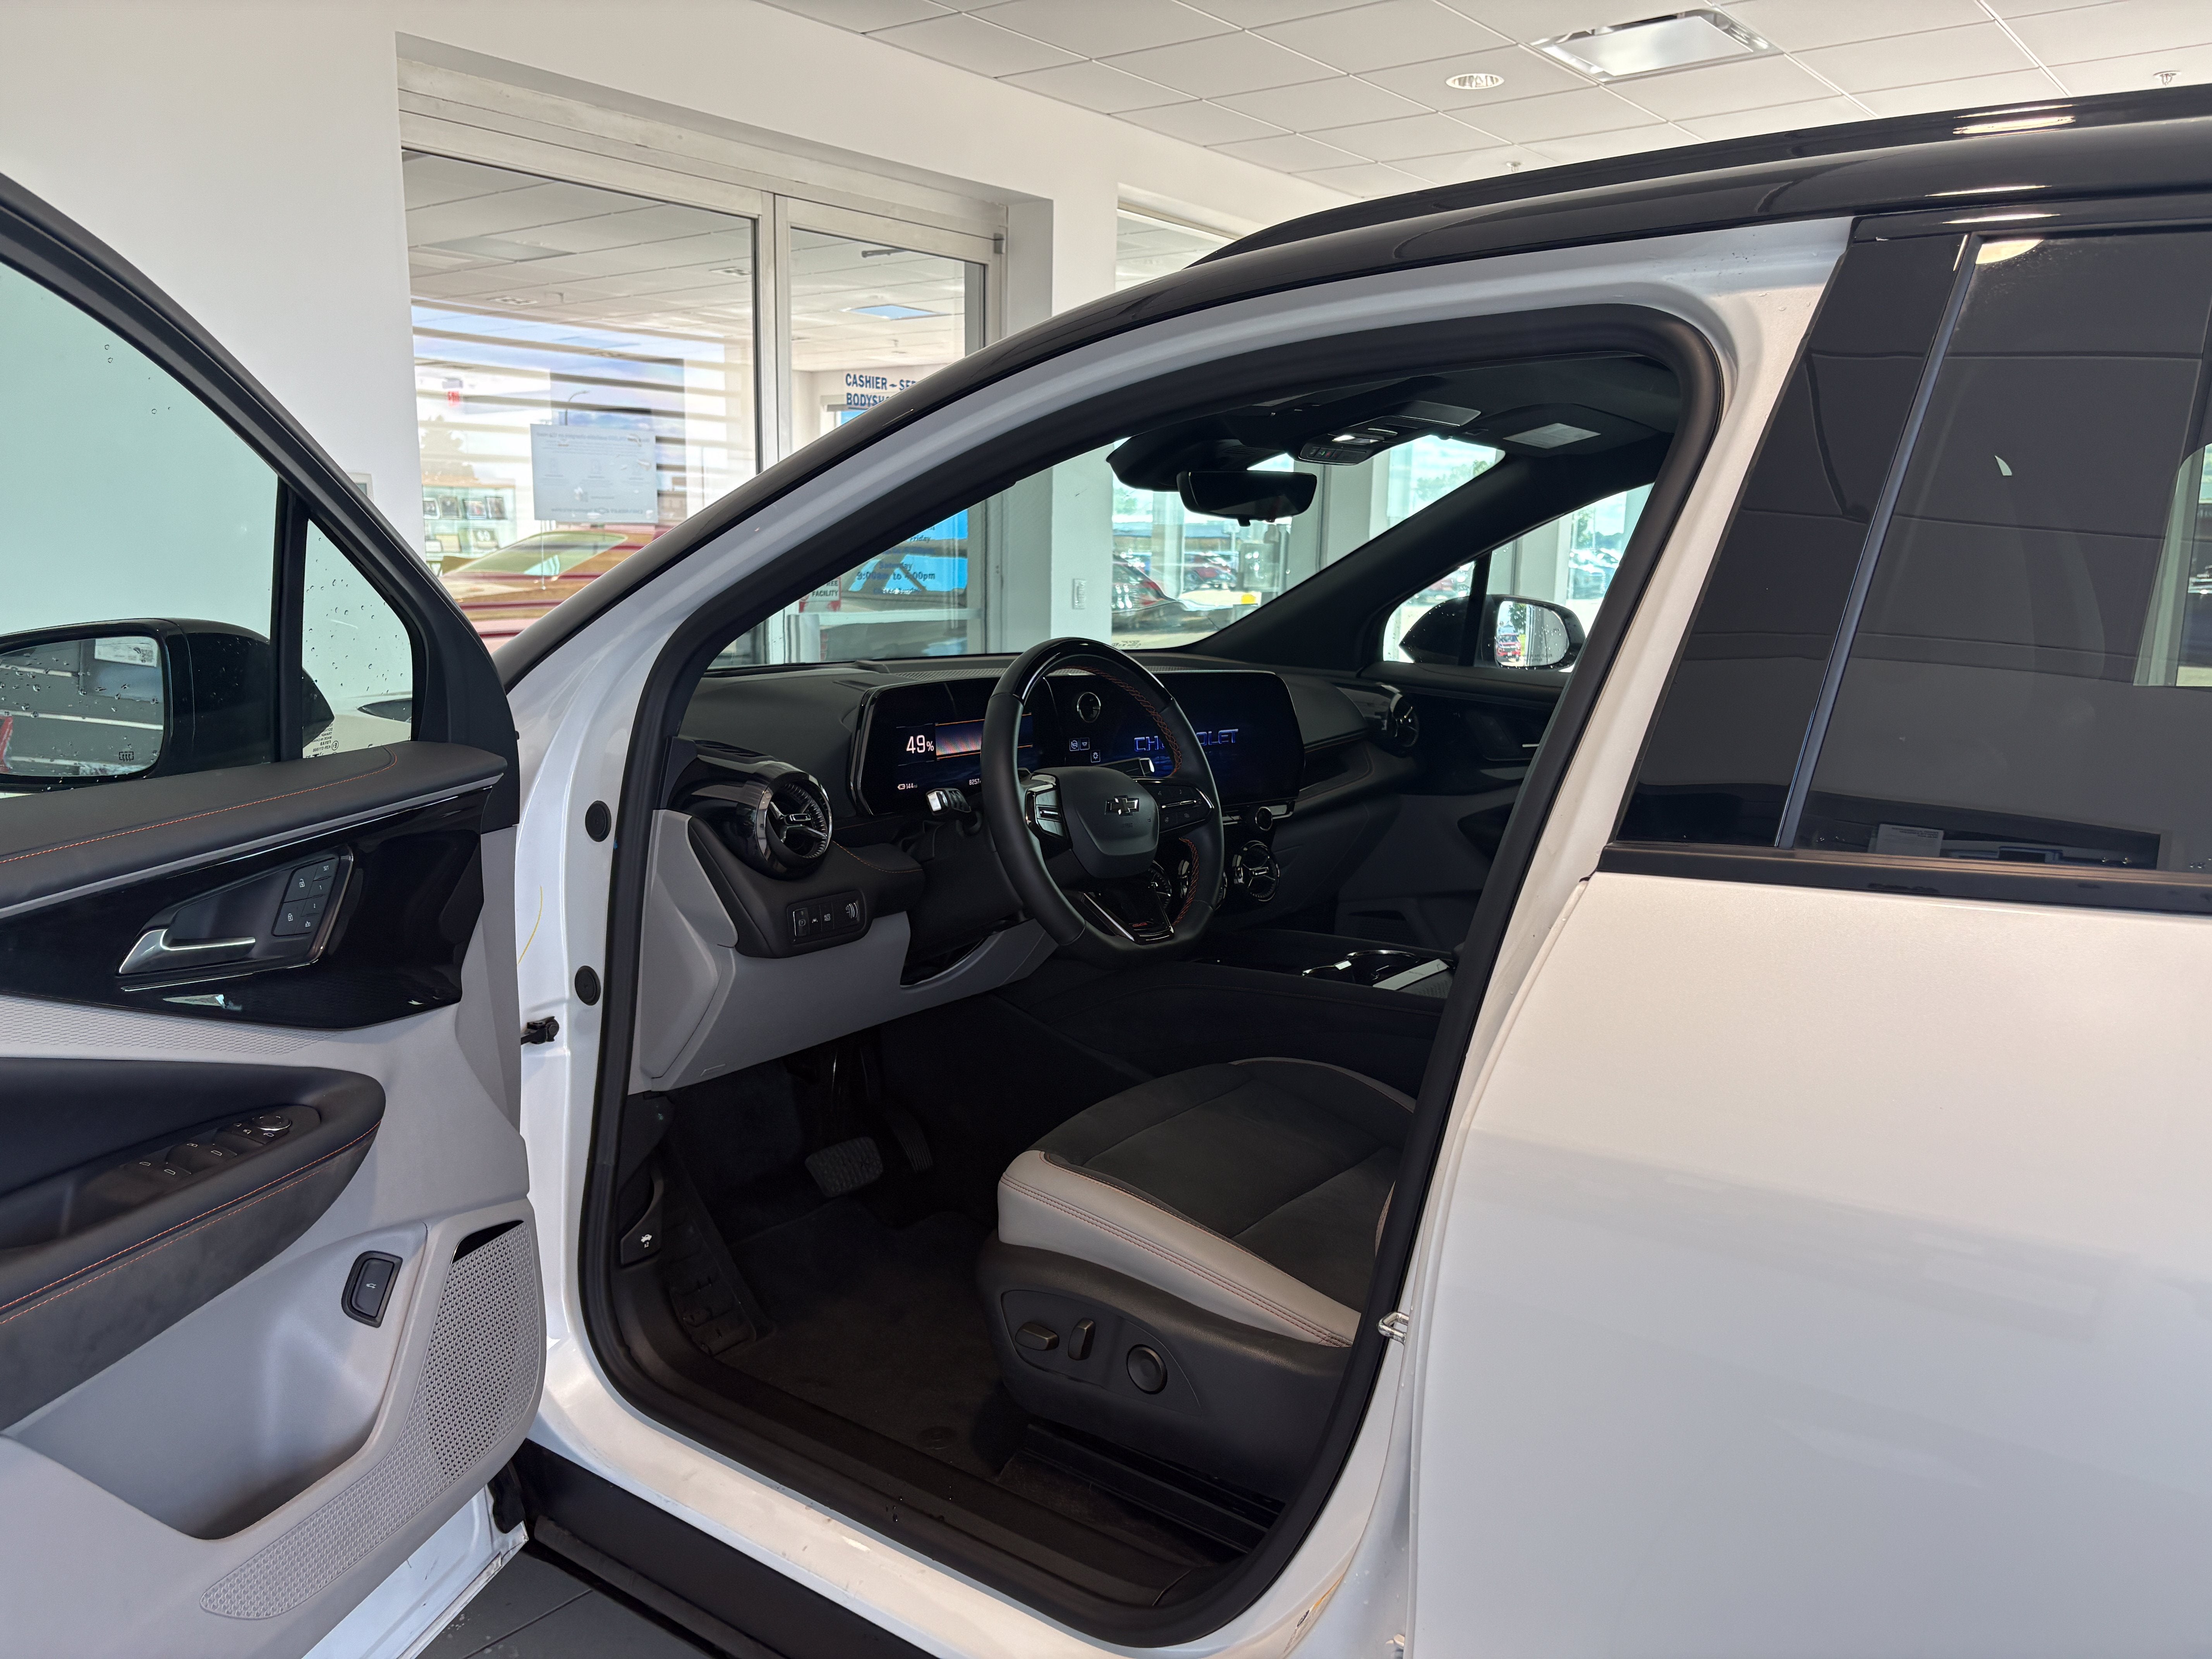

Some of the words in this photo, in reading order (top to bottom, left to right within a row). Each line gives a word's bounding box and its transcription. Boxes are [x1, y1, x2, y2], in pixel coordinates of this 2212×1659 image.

[846, 373, 888, 390] CASHIER
[846, 392, 890, 407] BODYSH
[893, 572, 902, 580] to
[906, 735, 934, 754] 49%
[1134, 728, 1238, 752] CHOLET
